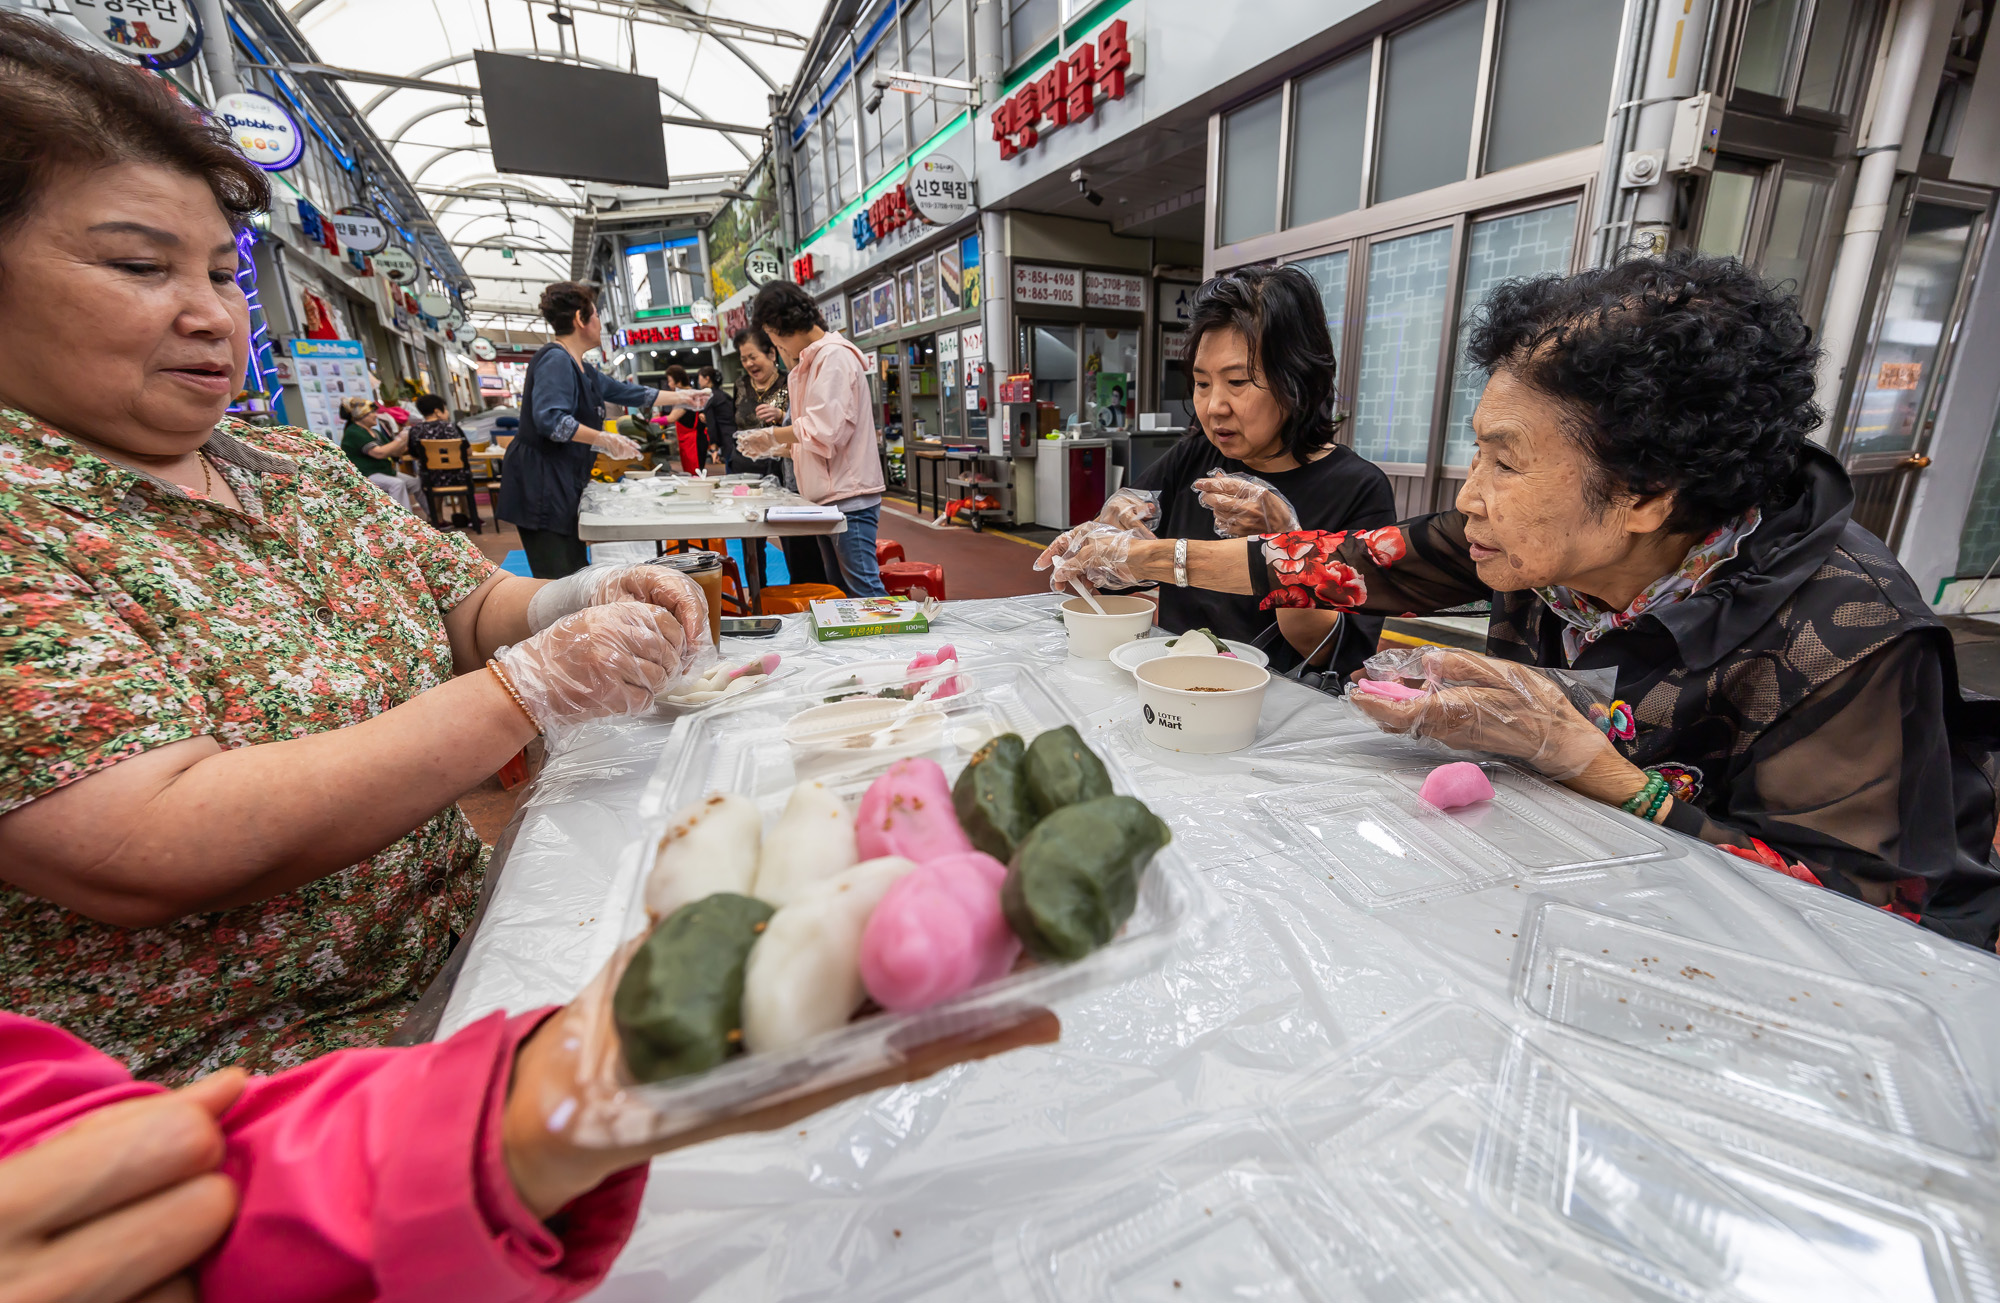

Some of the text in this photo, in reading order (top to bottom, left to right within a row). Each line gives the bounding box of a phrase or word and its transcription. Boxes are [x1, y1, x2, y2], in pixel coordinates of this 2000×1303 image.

[991, 19, 1131, 161] 전통떡골목
[915, 179, 967, 200] 신호떡집
[752, 261, 779, 274] 장터
[1157, 711, 1182, 722] LOTTE
[1158, 718, 1183, 730] Mart
